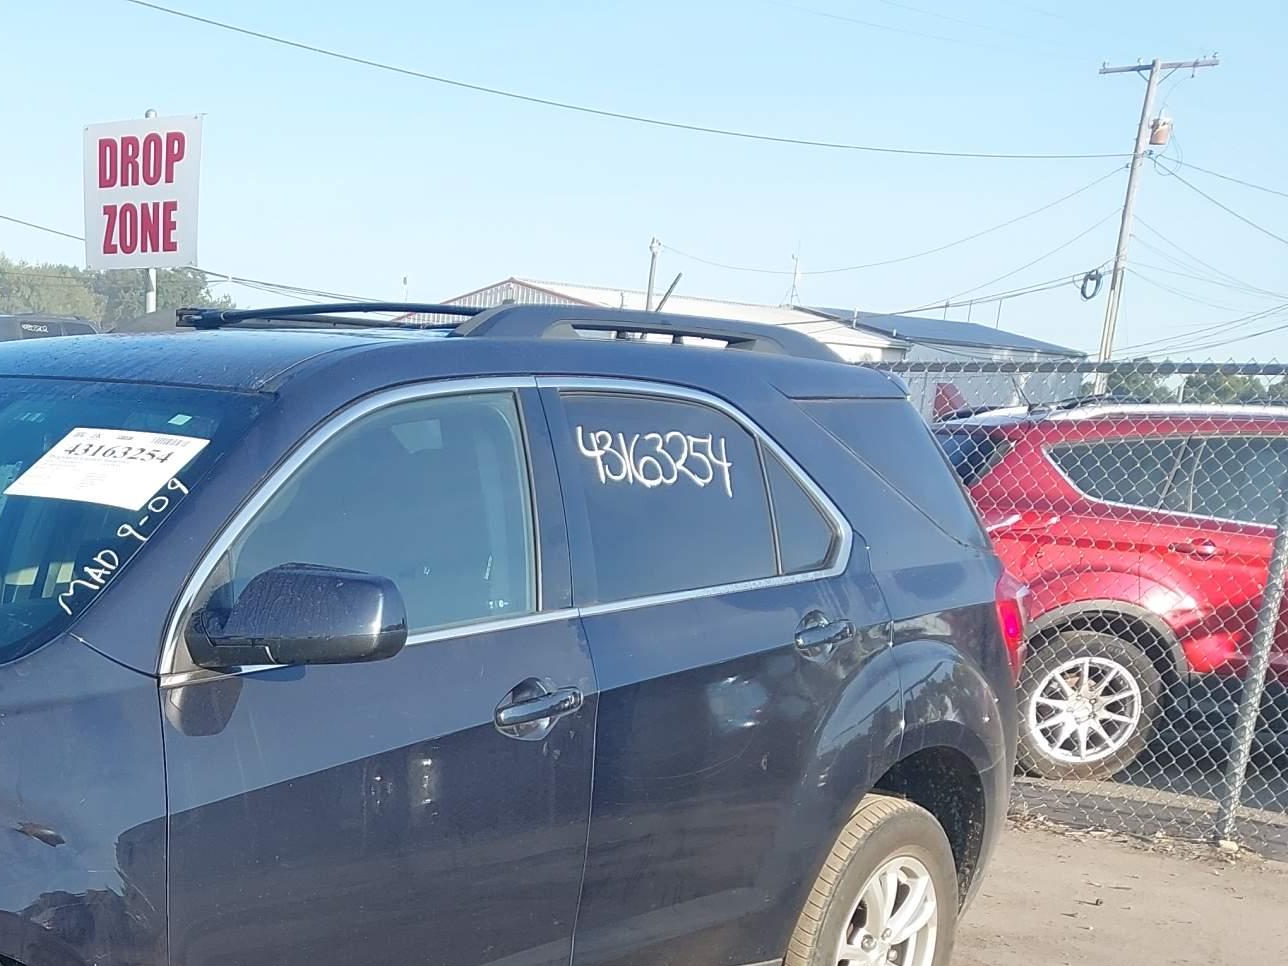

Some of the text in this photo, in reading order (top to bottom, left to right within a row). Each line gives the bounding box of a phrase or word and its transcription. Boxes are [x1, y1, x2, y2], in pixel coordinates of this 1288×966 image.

[98, 131, 186, 189] DROP
[102, 200, 178, 255] ZONE
[63, 442, 175, 463] 43163254
[575, 425, 734, 499] 43163254
